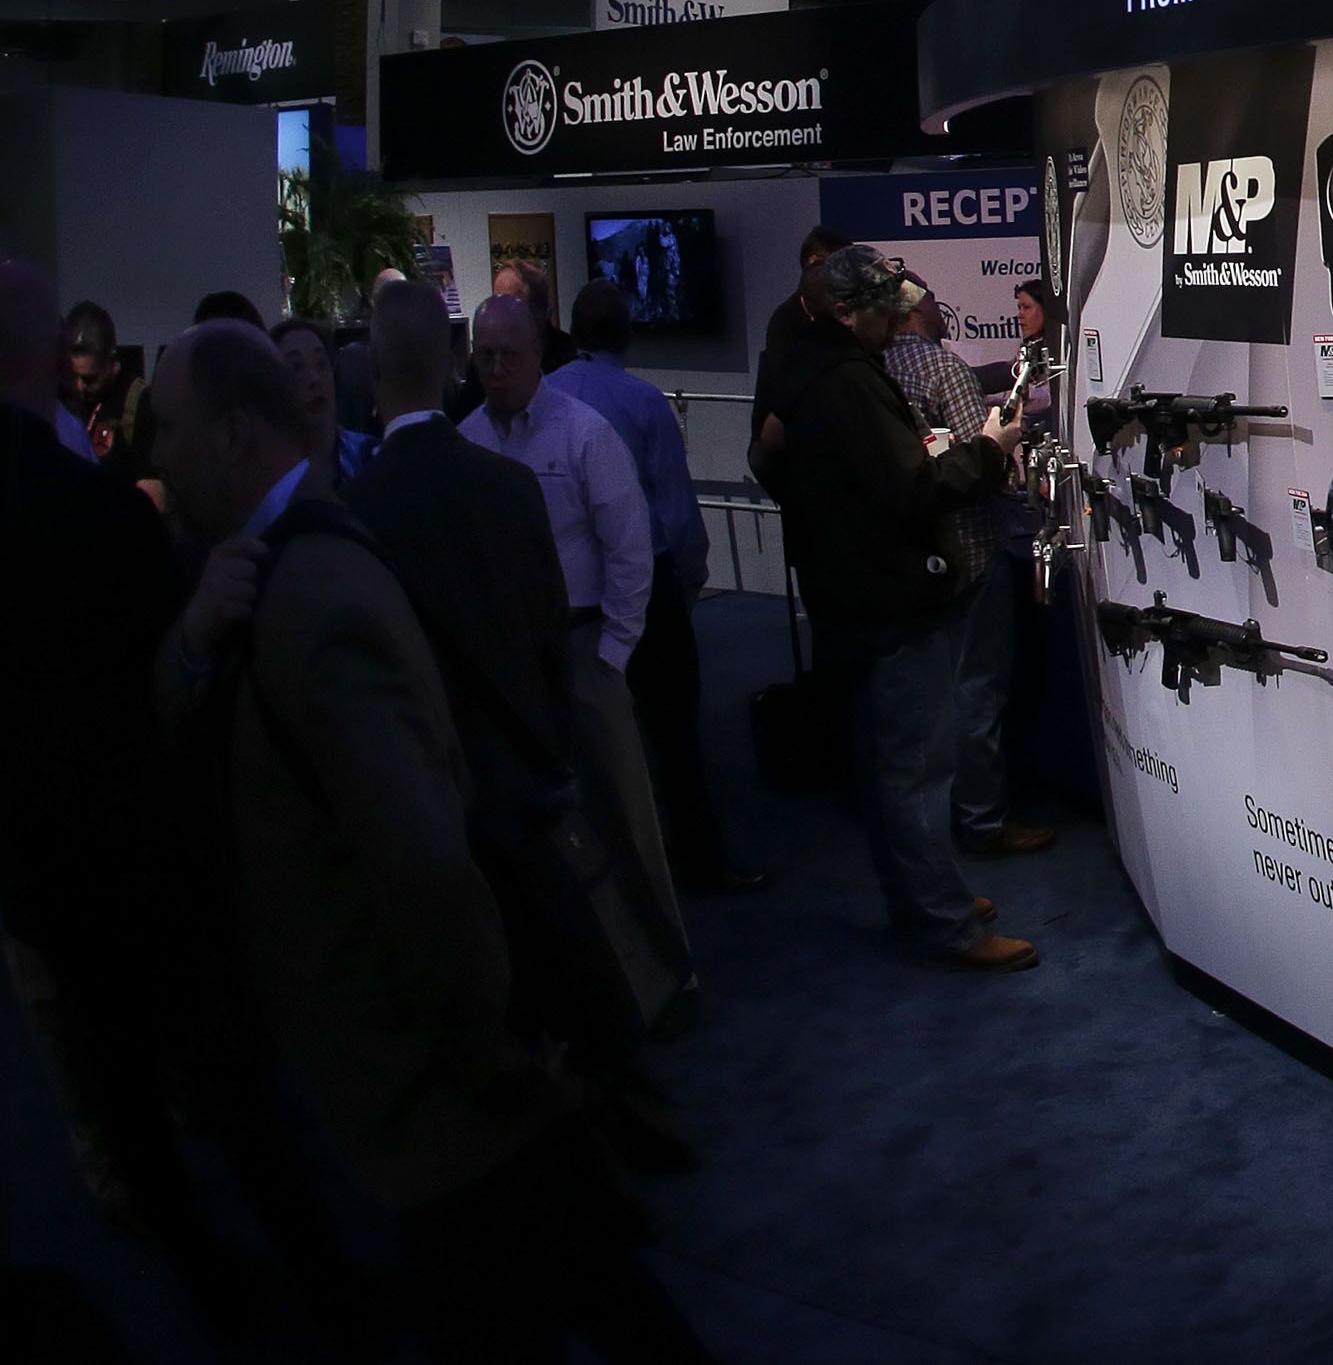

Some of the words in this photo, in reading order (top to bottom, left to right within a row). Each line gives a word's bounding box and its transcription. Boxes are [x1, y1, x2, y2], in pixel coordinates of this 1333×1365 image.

[200, 38, 294, 87] Remington
[663, 131, 697, 153] Law
[703, 122, 823, 149] Enforcement
[902, 186, 1037, 227] RECEP
[981, 259, 1041, 276] Welco
[1253, 849, 1302, 894] never
